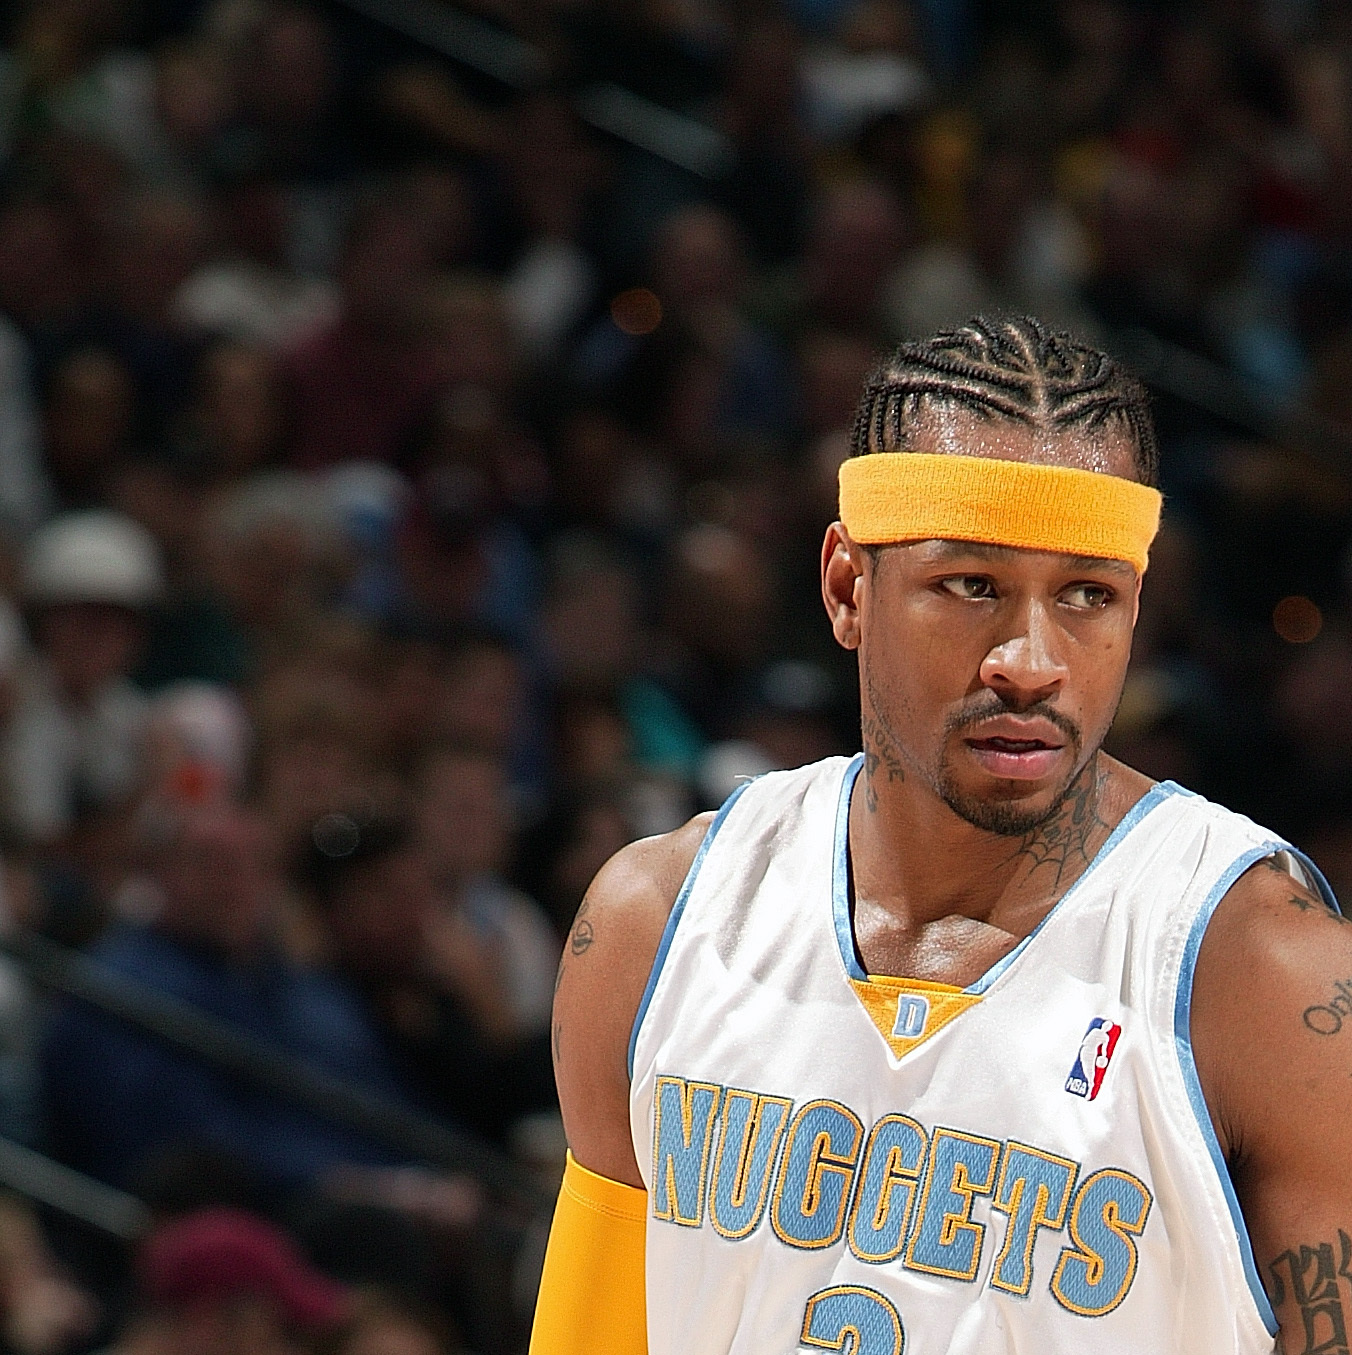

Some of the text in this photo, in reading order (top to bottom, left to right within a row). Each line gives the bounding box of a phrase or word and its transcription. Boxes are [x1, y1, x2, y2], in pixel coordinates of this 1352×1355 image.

[893, 993, 930, 1038] D
[1065, 1076, 1089, 1097] NBA
[653, 1074, 1154, 1318] NUGGETS
